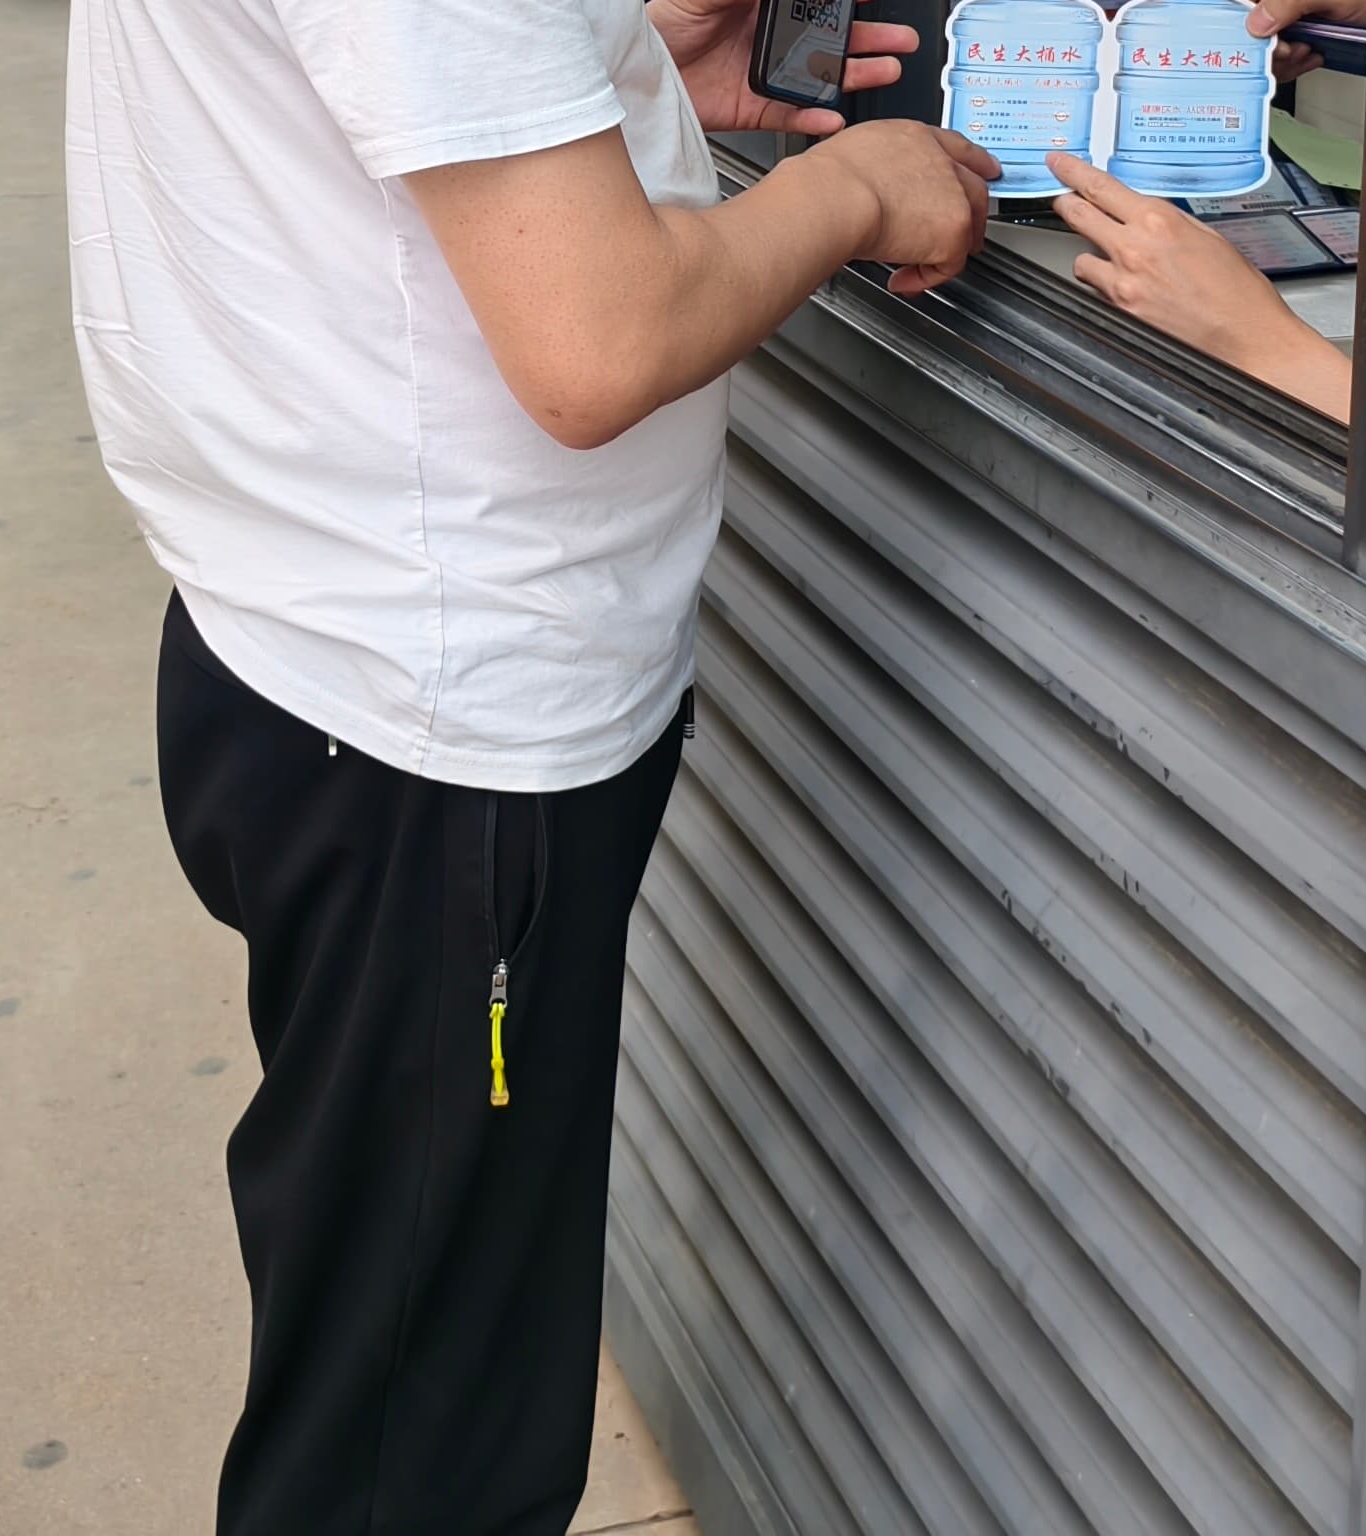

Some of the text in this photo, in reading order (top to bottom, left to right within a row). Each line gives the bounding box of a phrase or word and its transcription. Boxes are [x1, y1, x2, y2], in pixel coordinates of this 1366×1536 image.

[967, 42, 1083, 64] 民生大桶水
[1132, 47, 1251, 68] 民生大桶水
